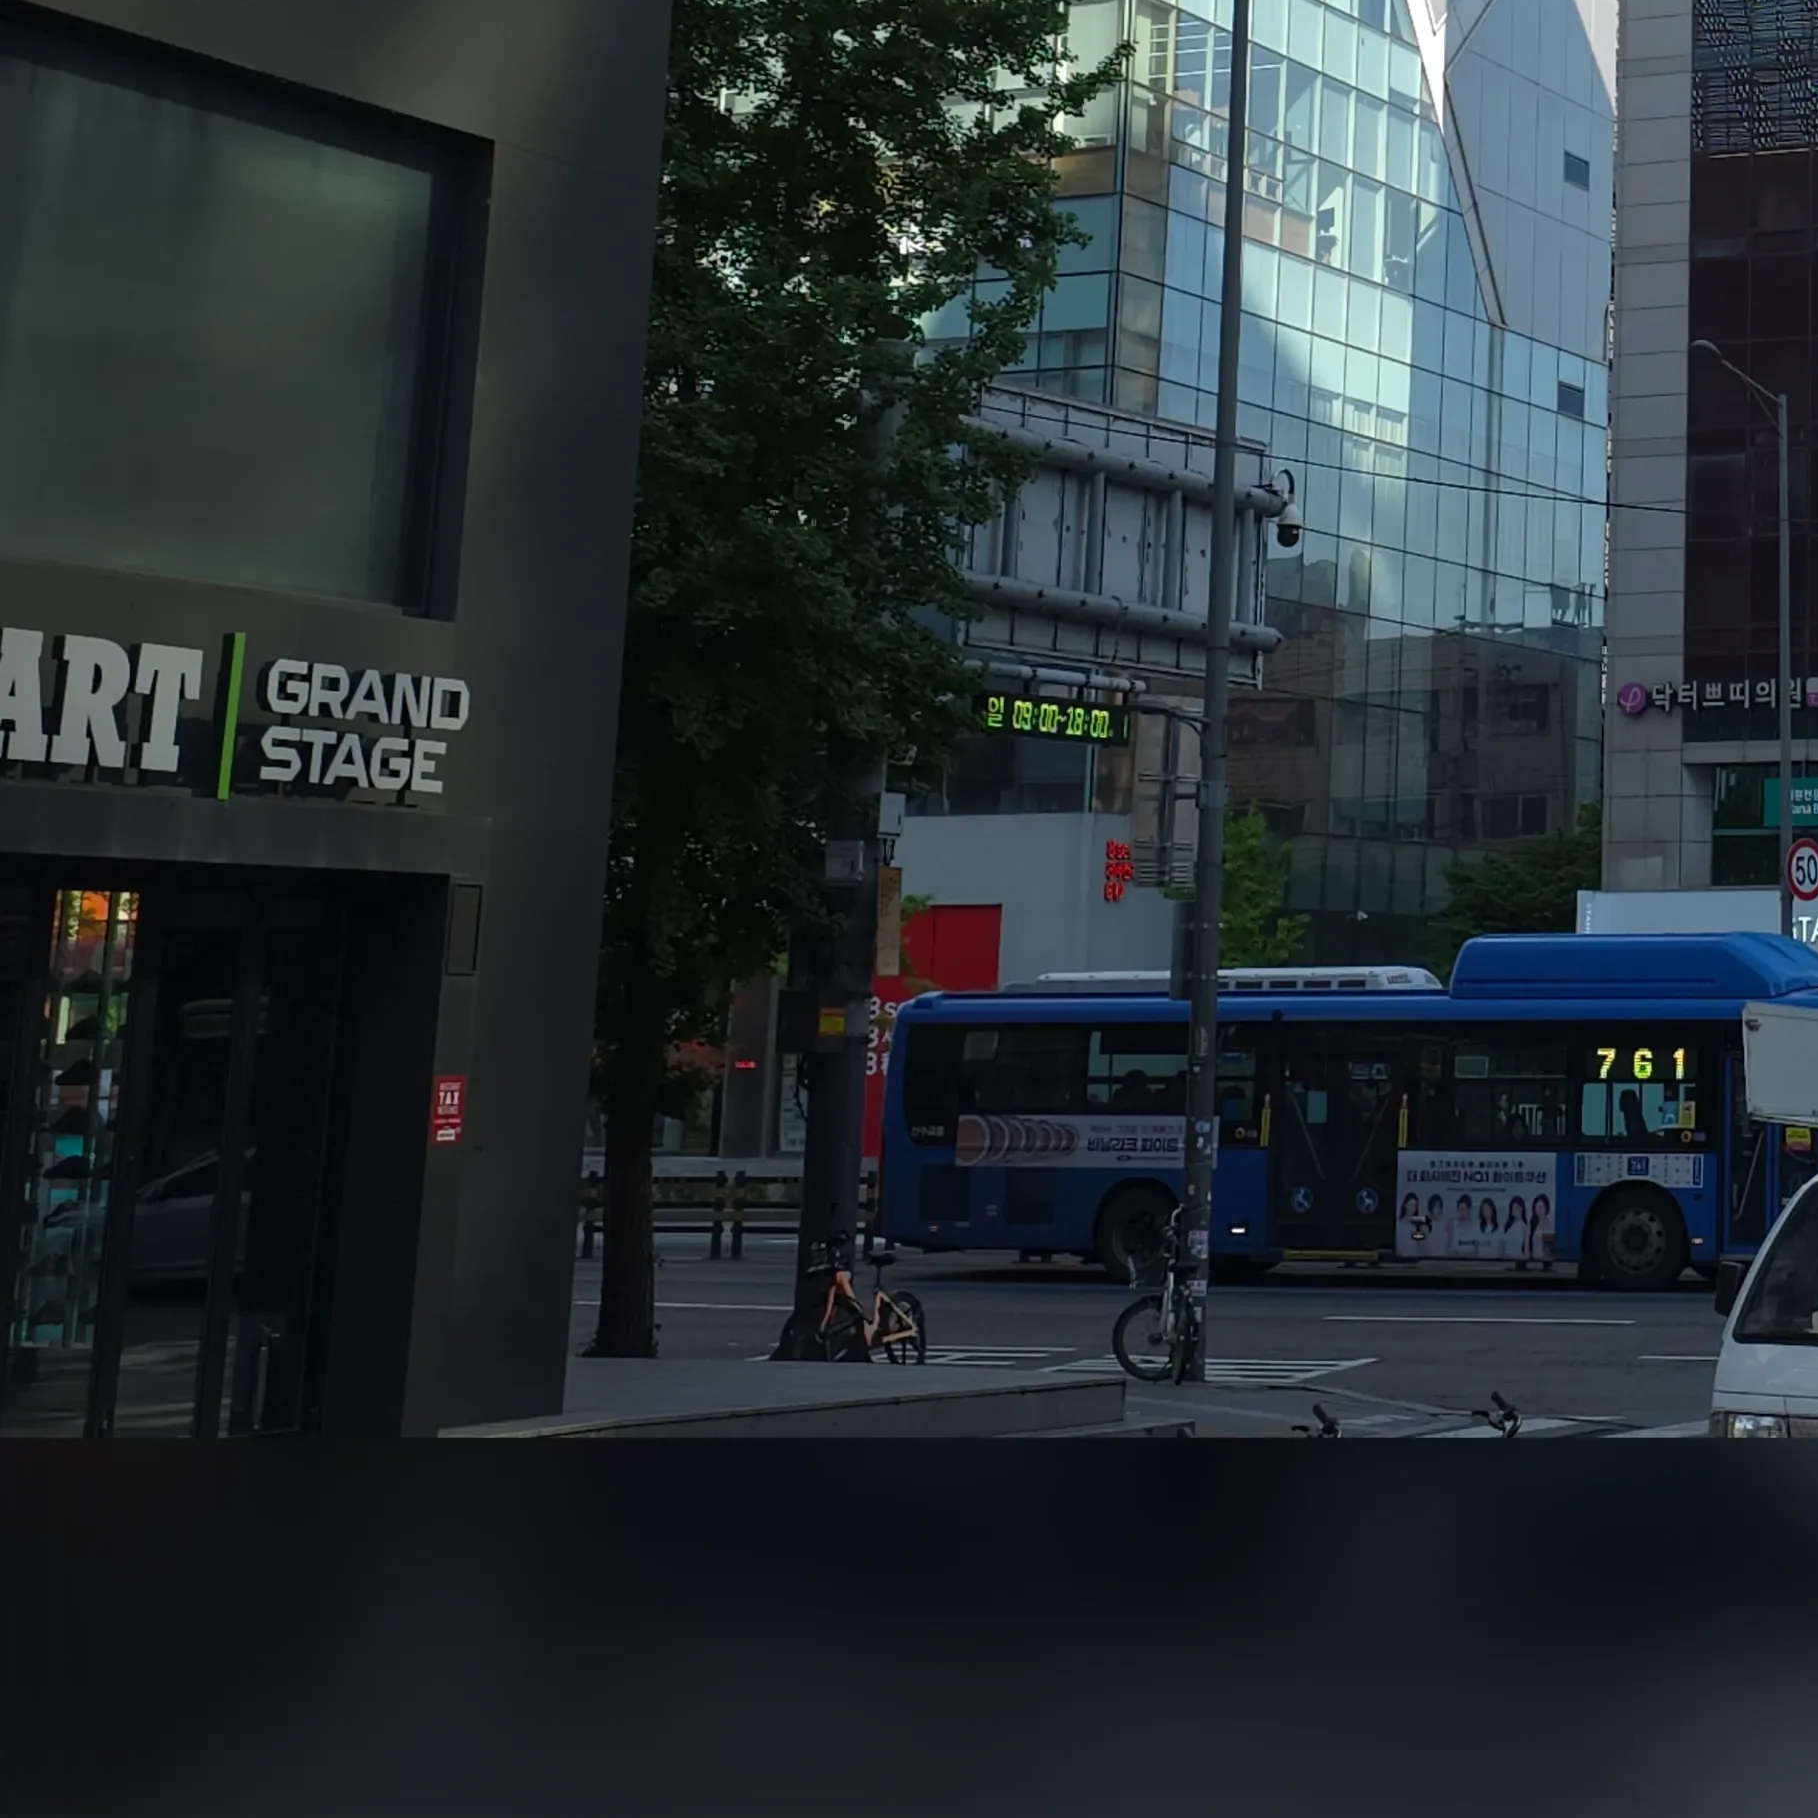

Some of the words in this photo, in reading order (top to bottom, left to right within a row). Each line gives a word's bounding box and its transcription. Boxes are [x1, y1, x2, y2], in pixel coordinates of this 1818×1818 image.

[267, 658, 470, 730] GRAND
[987, 696, 1005, 728] 일
[260, 725, 447, 793] STAGE
[1795, 854, 1818, 886] 50
[1597, 1047, 1686, 1080] 761
[439, 1090, 460, 1105] TAX
